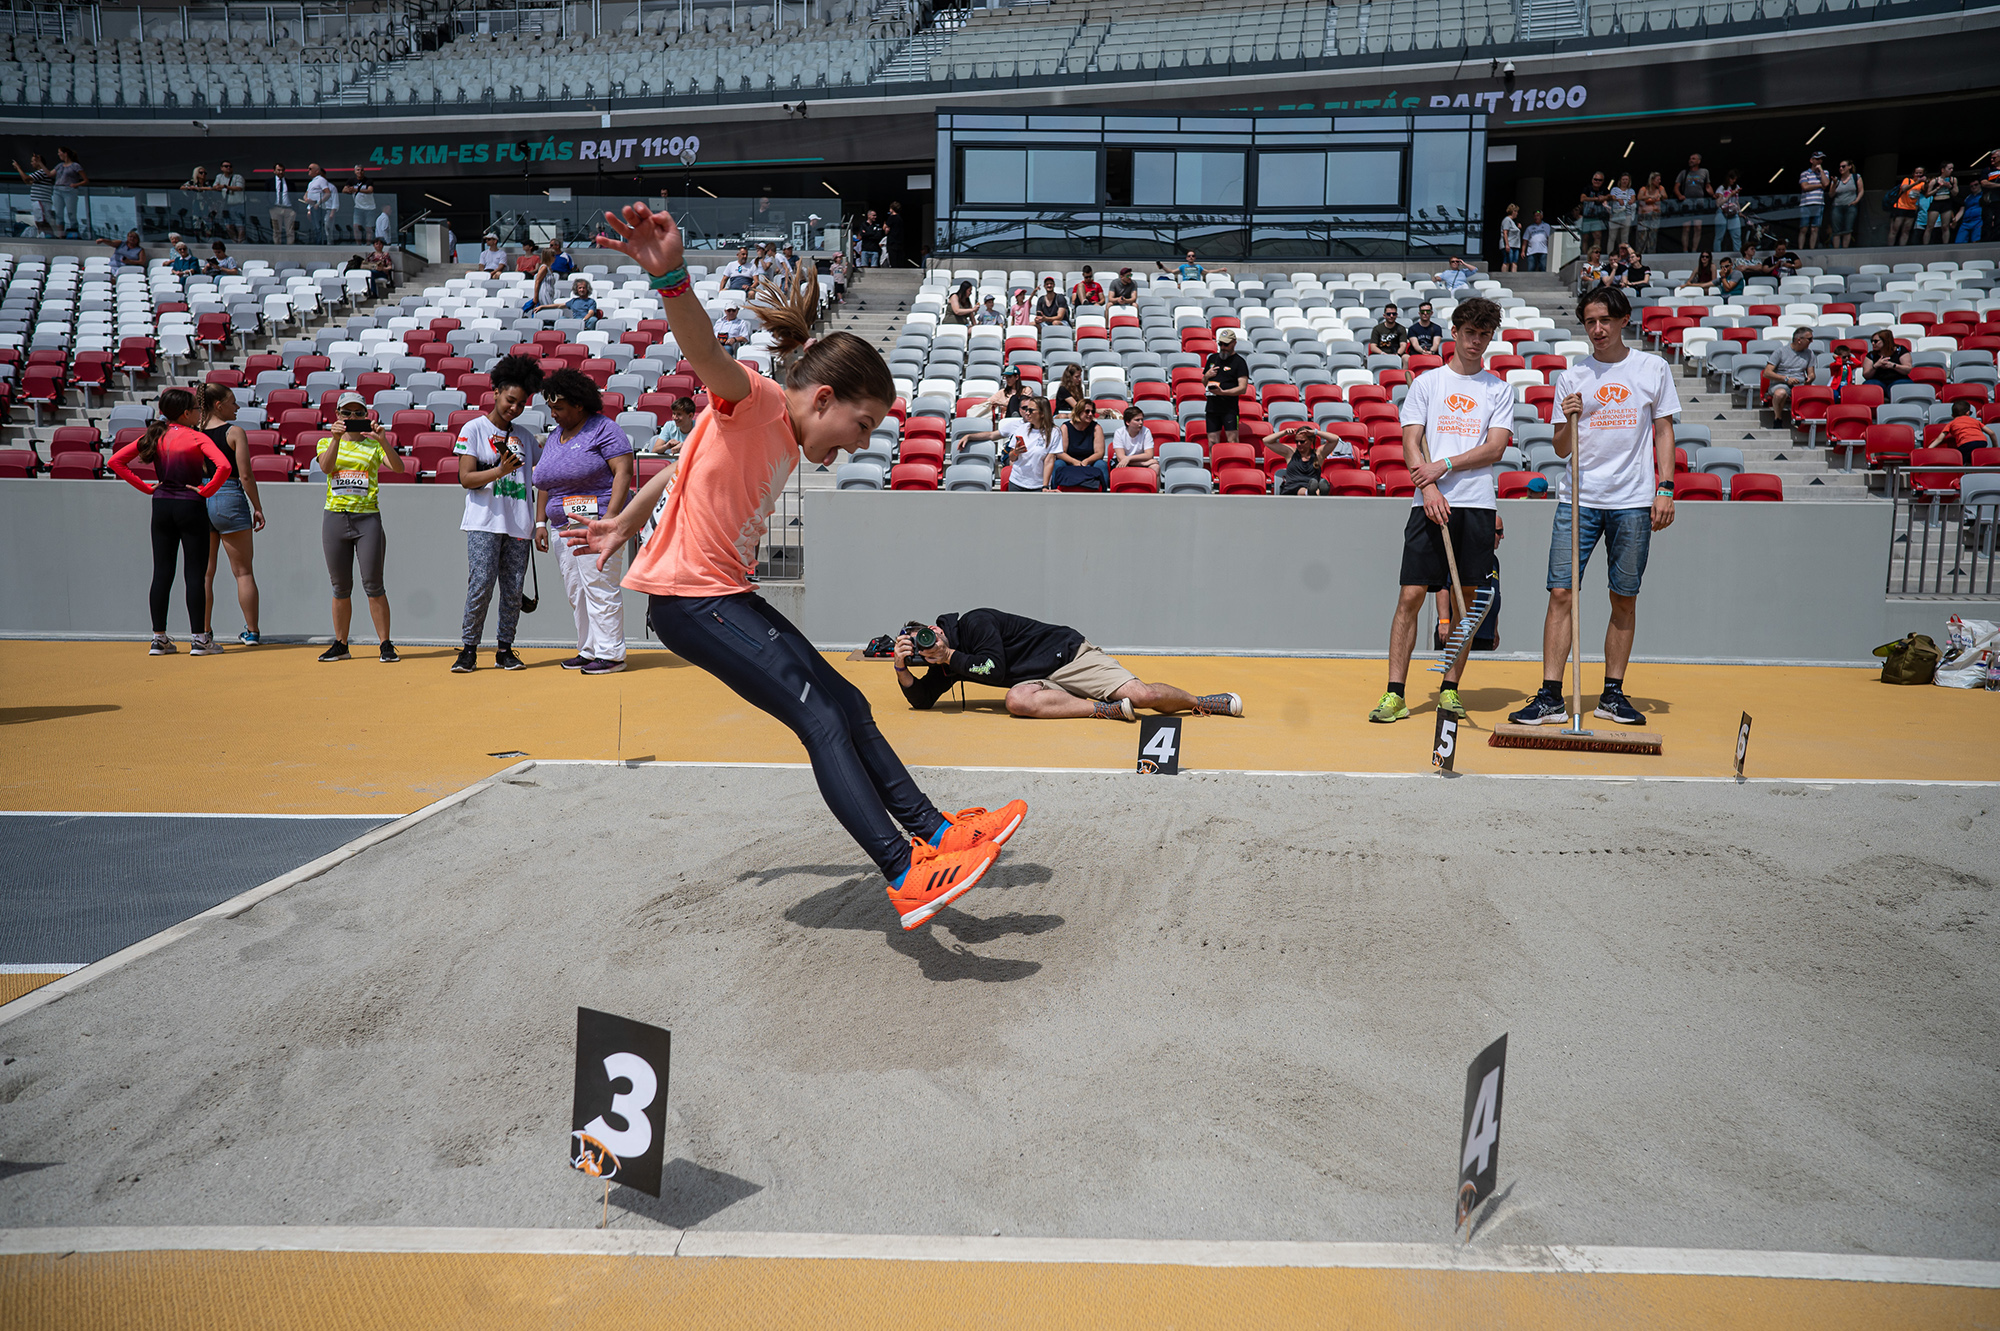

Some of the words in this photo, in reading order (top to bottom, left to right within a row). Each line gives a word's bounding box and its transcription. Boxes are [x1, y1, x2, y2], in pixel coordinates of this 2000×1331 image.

[1509, 84, 1587, 113] 11:00
[369, 146, 404, 165] 4.5
[409, 143, 490, 164] KM-ES
[495, 135, 574, 162] FUTÁS
[579, 138, 638, 162] RAJT
[640, 135, 700, 157] 11:00
[1437, 425, 1471, 434] BUDAPEST
[1590, 413, 1637, 421] CHAMPIONSHIPS
[1590, 419, 1627, 427] BUDAPEST
[571, 504, 587, 513] 582
[1142, 726, 1176, 763] 4
[1437, 719, 1457, 758] 5
[1737, 723, 1749, 760] 6
[582, 1051, 658, 1159] 3
[1461, 1065, 1501, 1176] 4
